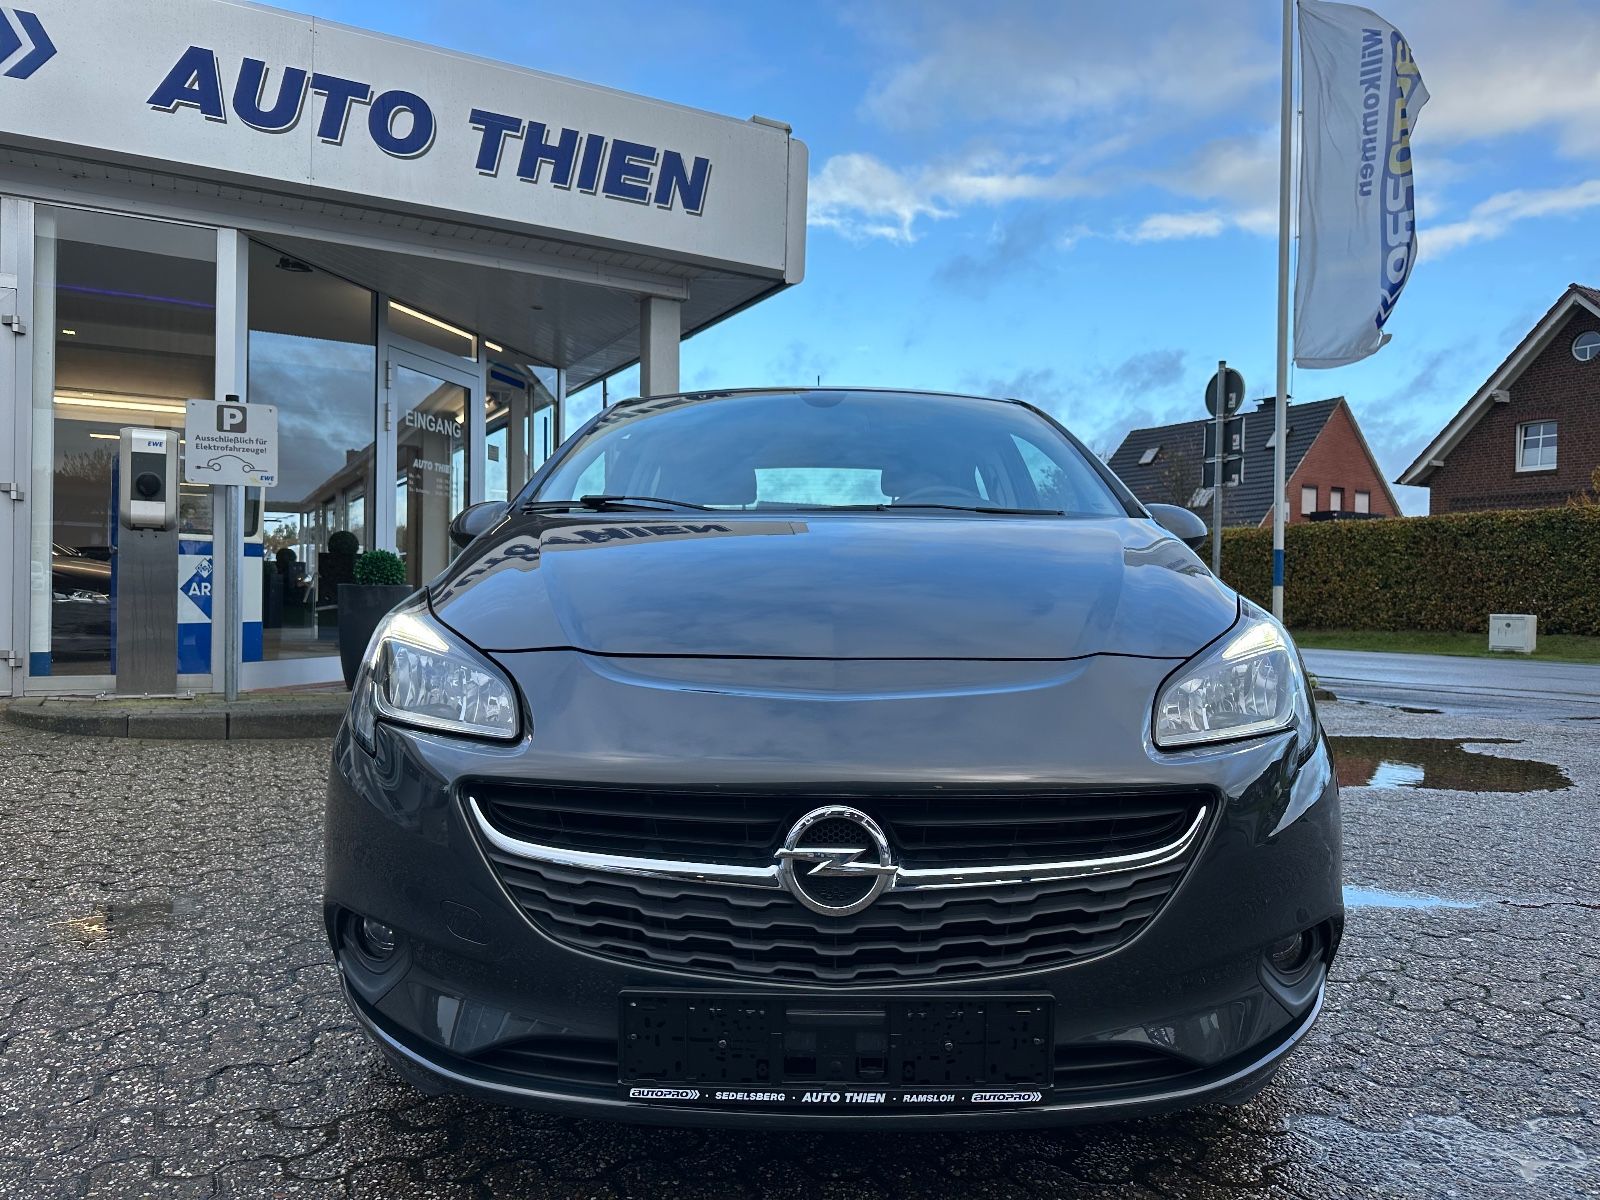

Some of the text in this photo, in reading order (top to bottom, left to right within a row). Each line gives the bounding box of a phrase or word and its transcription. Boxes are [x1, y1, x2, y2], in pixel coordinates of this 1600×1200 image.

[146, 45, 712, 216] AUTO THIEN
[223, 407, 244, 431] P
[405, 409, 462, 438] EINGANG
[147, 440, 164, 448] EWE
[195, 434, 268, 446] Ausschließlich für
[195, 443, 267, 456] Elektrofahrzeuge!
[412, 458, 452, 474] AUTO THIE
[715, 1091, 786, 1101] SEDELSBERG
[801, 1092, 841, 1103] AUTO
[844, 1092, 887, 1103] THIEN
[902, 1094, 956, 1103] RAMSLOH
